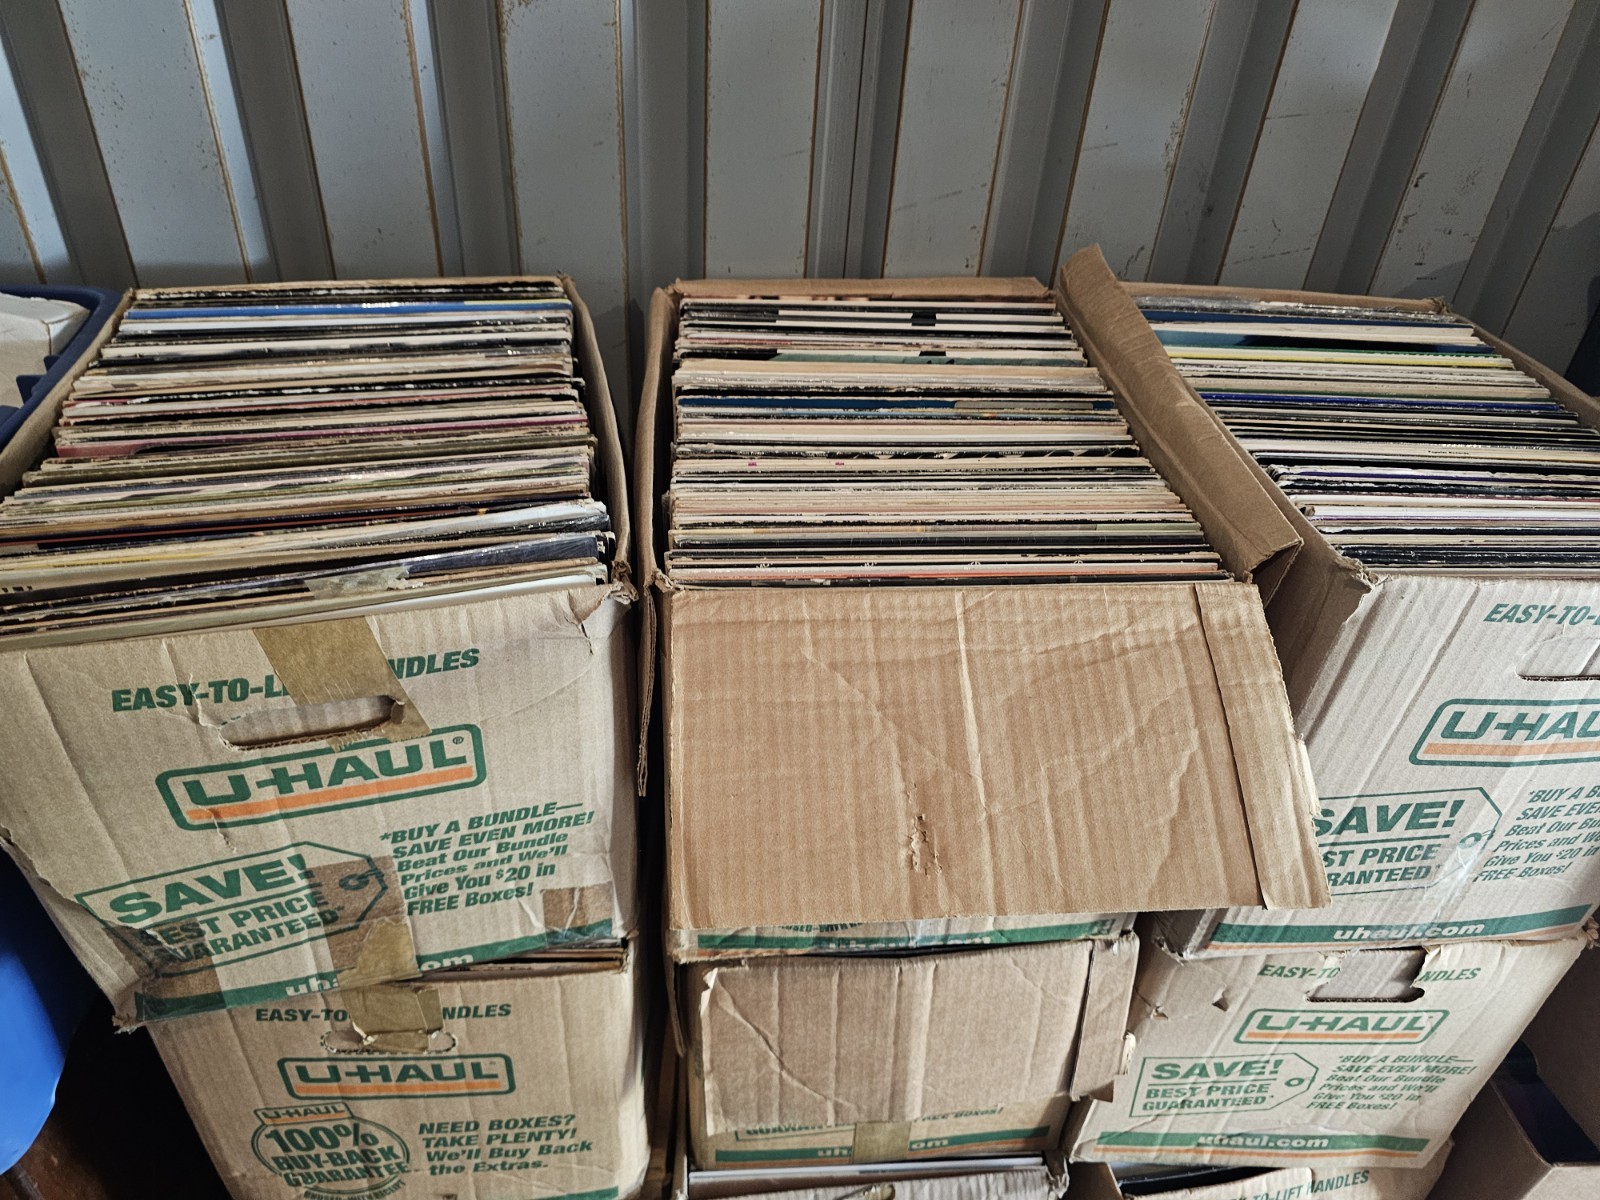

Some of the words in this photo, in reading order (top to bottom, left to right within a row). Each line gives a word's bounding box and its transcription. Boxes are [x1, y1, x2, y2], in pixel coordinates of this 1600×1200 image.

[1483, 603, 1600, 626] EASY-TO-
[112, 674, 290, 712] EASY-TO-L
[388, 648, 480, 679] NDLES
[1440, 710, 1600, 742] U-HA
[1565, 786, 1585, 800] A
[1313, 799, 1465, 837] SAVE!
[1516, 804, 1567, 820] SAVE
[392, 837, 452, 859] SAVE
[458, 828, 517, 847] EVEN
[522, 811, 595, 835] MORE!
[444, 820, 460, 835] A
[1505, 822, 1546, 836] Beat
[1546, 821, 1577, 833] Our
[397, 852, 448, 872] Beat
[452, 846, 490, 862] Our
[496, 832, 568, 853] Bundle
[1492, 839, 1547, 852] Prices
[1547, 833, 1582, 847] and
[400, 863, 467, 885] Prices
[474, 854, 512, 870] and
[519, 844, 568, 863] We'll
[1322, 849, 1355, 868] ST
[1358, 843, 1441, 866] PRICE
[1483, 855, 1521, 868] Give
[1523, 852, 1553, 864] You
[1556, 847, 1583, 860] $20
[404, 879, 449, 900] Give
[455, 873, 491, 891] You
[495, 864, 530, 883] $20
[536, 863, 556, 877] in
[1327, 863, 1441, 887] RANTEED
[1472, 867, 1518, 882] FREE
[1517, 861, 1573, 878] Boxes!
[110, 853, 315, 924] SAVE!
[407, 895, 459, 916] FREE
[465, 882, 534, 907] Boxes!
[228, 891, 329, 928] PRICE
[1333, 923, 1485, 941] uhaul.com
[1257, 964, 1340, 979] EASY-TO
[1418, 967, 1481, 983] NDLES
[255, 1008, 350, 1022] EASY-TO
[442, 1003, 511, 1020] NDLES
[1256, 1015, 1425, 1031] U-HAUL
[1151, 1059, 1284, 1080] SAVE!
[1377, 1055, 1390, 1063] A
[295, 1062, 499, 1084] U-HAUL
[1325, 1074, 1362, 1082] Beat
[1363, 1074, 1393, 1083] Our
[1394, 1075, 1446, 1084] Bundle
[1332, 1065, 1376, 1073] SAVE
[1377, 1065, 1421, 1073] EVEN
[1421, 1065, 1477, 1075] MORE!
[1145, 1086, 1202, 1099] BEST
[1206, 1083, 1271, 1097] PRICE
[1312, 1092, 1345, 1100] Give
[1350, 1092, 1375, 1100] You
[1319, 1083, 1366, 1091] Prices
[1368, 1084, 1399, 1092] and
[261, 1105, 345, 1119] U-HAUL
[1306, 1101, 1344, 1110] FREE
[1346, 1101, 1398, 1110] Boxes!
[418, 1120, 480, 1135] NEED
[488, 1114, 575, 1131] BOXES?
[264, 1121, 379, 1153] 100%
[422, 1135, 479, 1149] TAKE
[486, 1128, 577, 1145] PLENTY!
[1197, 1135, 1329, 1148] uhaul.com
[271, 1145, 401, 1172] BUY-BACK
[426, 1149, 480, 1162] We'll
[488, 1147, 531, 1160] Buy
[537, 1140, 593, 1156] Back
[283, 1160, 410, 1187] GUARANTEE
[429, 1162, 465, 1176] the
[472, 1159, 549, 1173] Extras.
[1306, 1170, 1369, 1195] HANDLES
